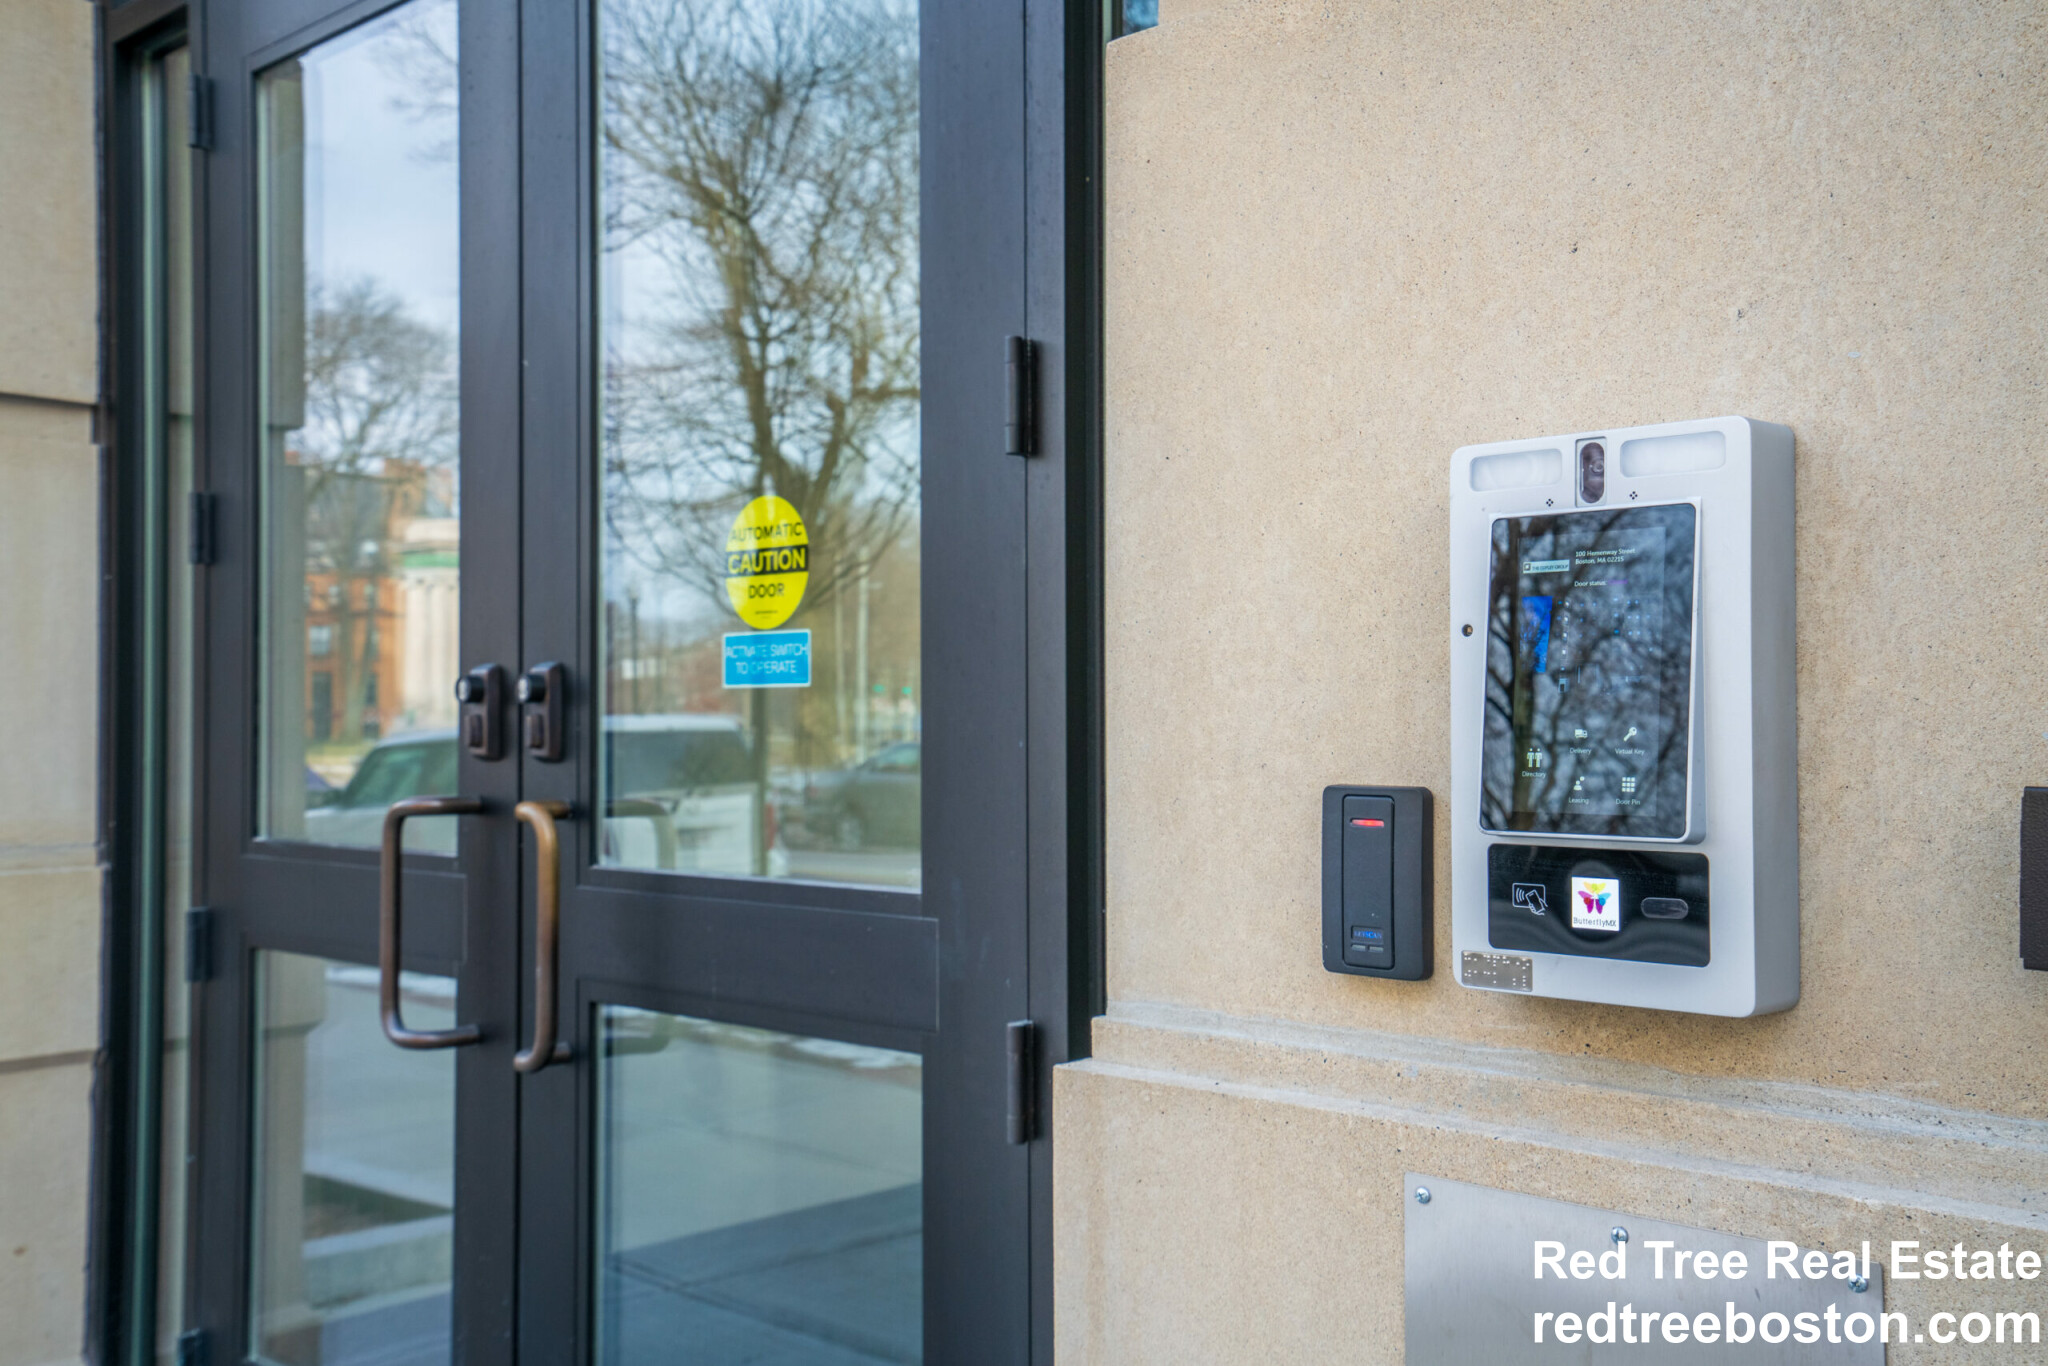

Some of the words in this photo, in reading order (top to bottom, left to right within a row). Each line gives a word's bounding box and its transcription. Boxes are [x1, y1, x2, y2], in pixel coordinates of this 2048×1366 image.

[730, 522, 803, 542] AUTOMATIC
[728, 548, 806, 574] CAUTION
[748, 583, 785, 599] DOOR
[726, 644, 767, 659] ACTIVATE
[770, 643, 808, 657] SWITCH
[735, 662, 748, 675] TO
[751, 660, 797, 675] OPERATE
[1568, 797, 1589, 805] Leasing
[1573, 917, 1617, 927] ButterflyMX
